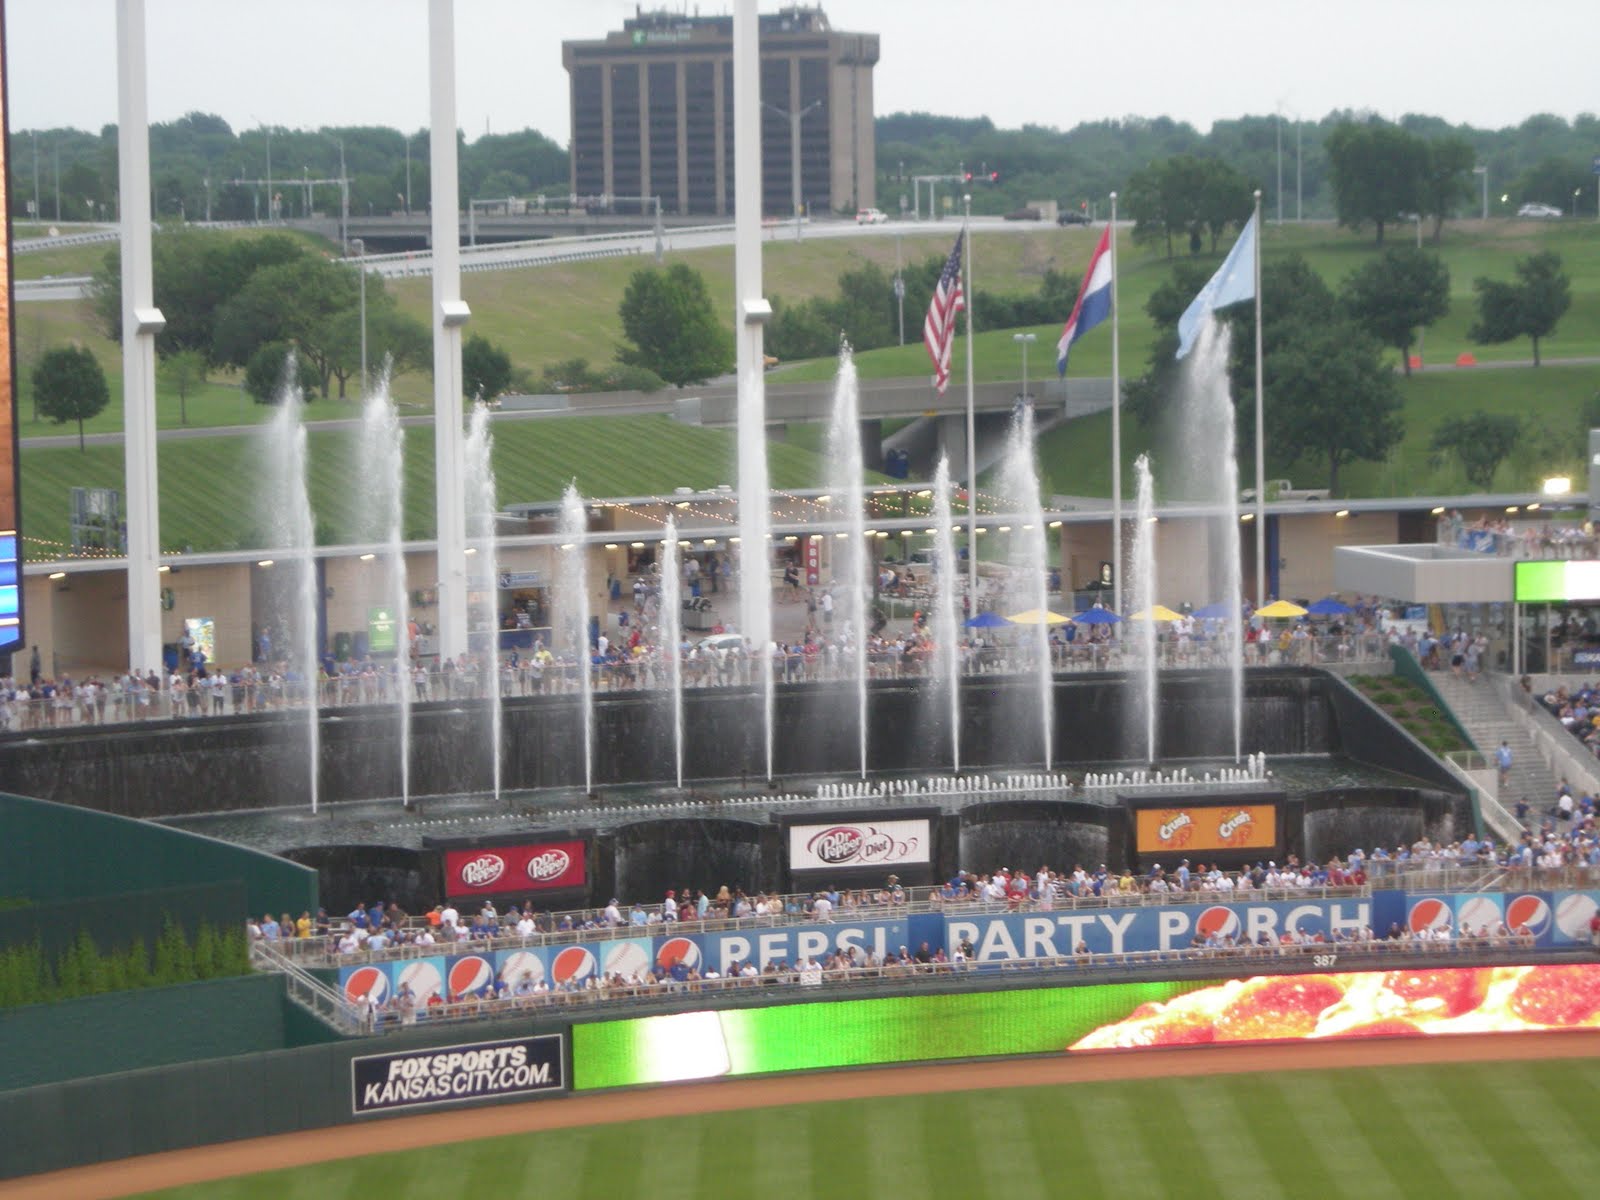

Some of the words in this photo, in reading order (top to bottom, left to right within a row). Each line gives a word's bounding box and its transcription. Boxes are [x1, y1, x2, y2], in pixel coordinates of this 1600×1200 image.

[1159, 812, 1191, 840] Crush
[1219, 810, 1251, 838] Crush
[823, 836, 863, 860] Pepper
[836, 831, 852, 843] Dr
[865, 839, 888, 857] Diet
[476, 858, 492, 870] Dr
[532, 857, 567, 879] Pepper
[542, 853, 558, 865] Dr
[466, 862, 501, 884] Pepper
[719, 926, 886, 978] PEPSI
[948, 912, 1137, 963] PARTY
[1313, 954, 1337, 967] 387
